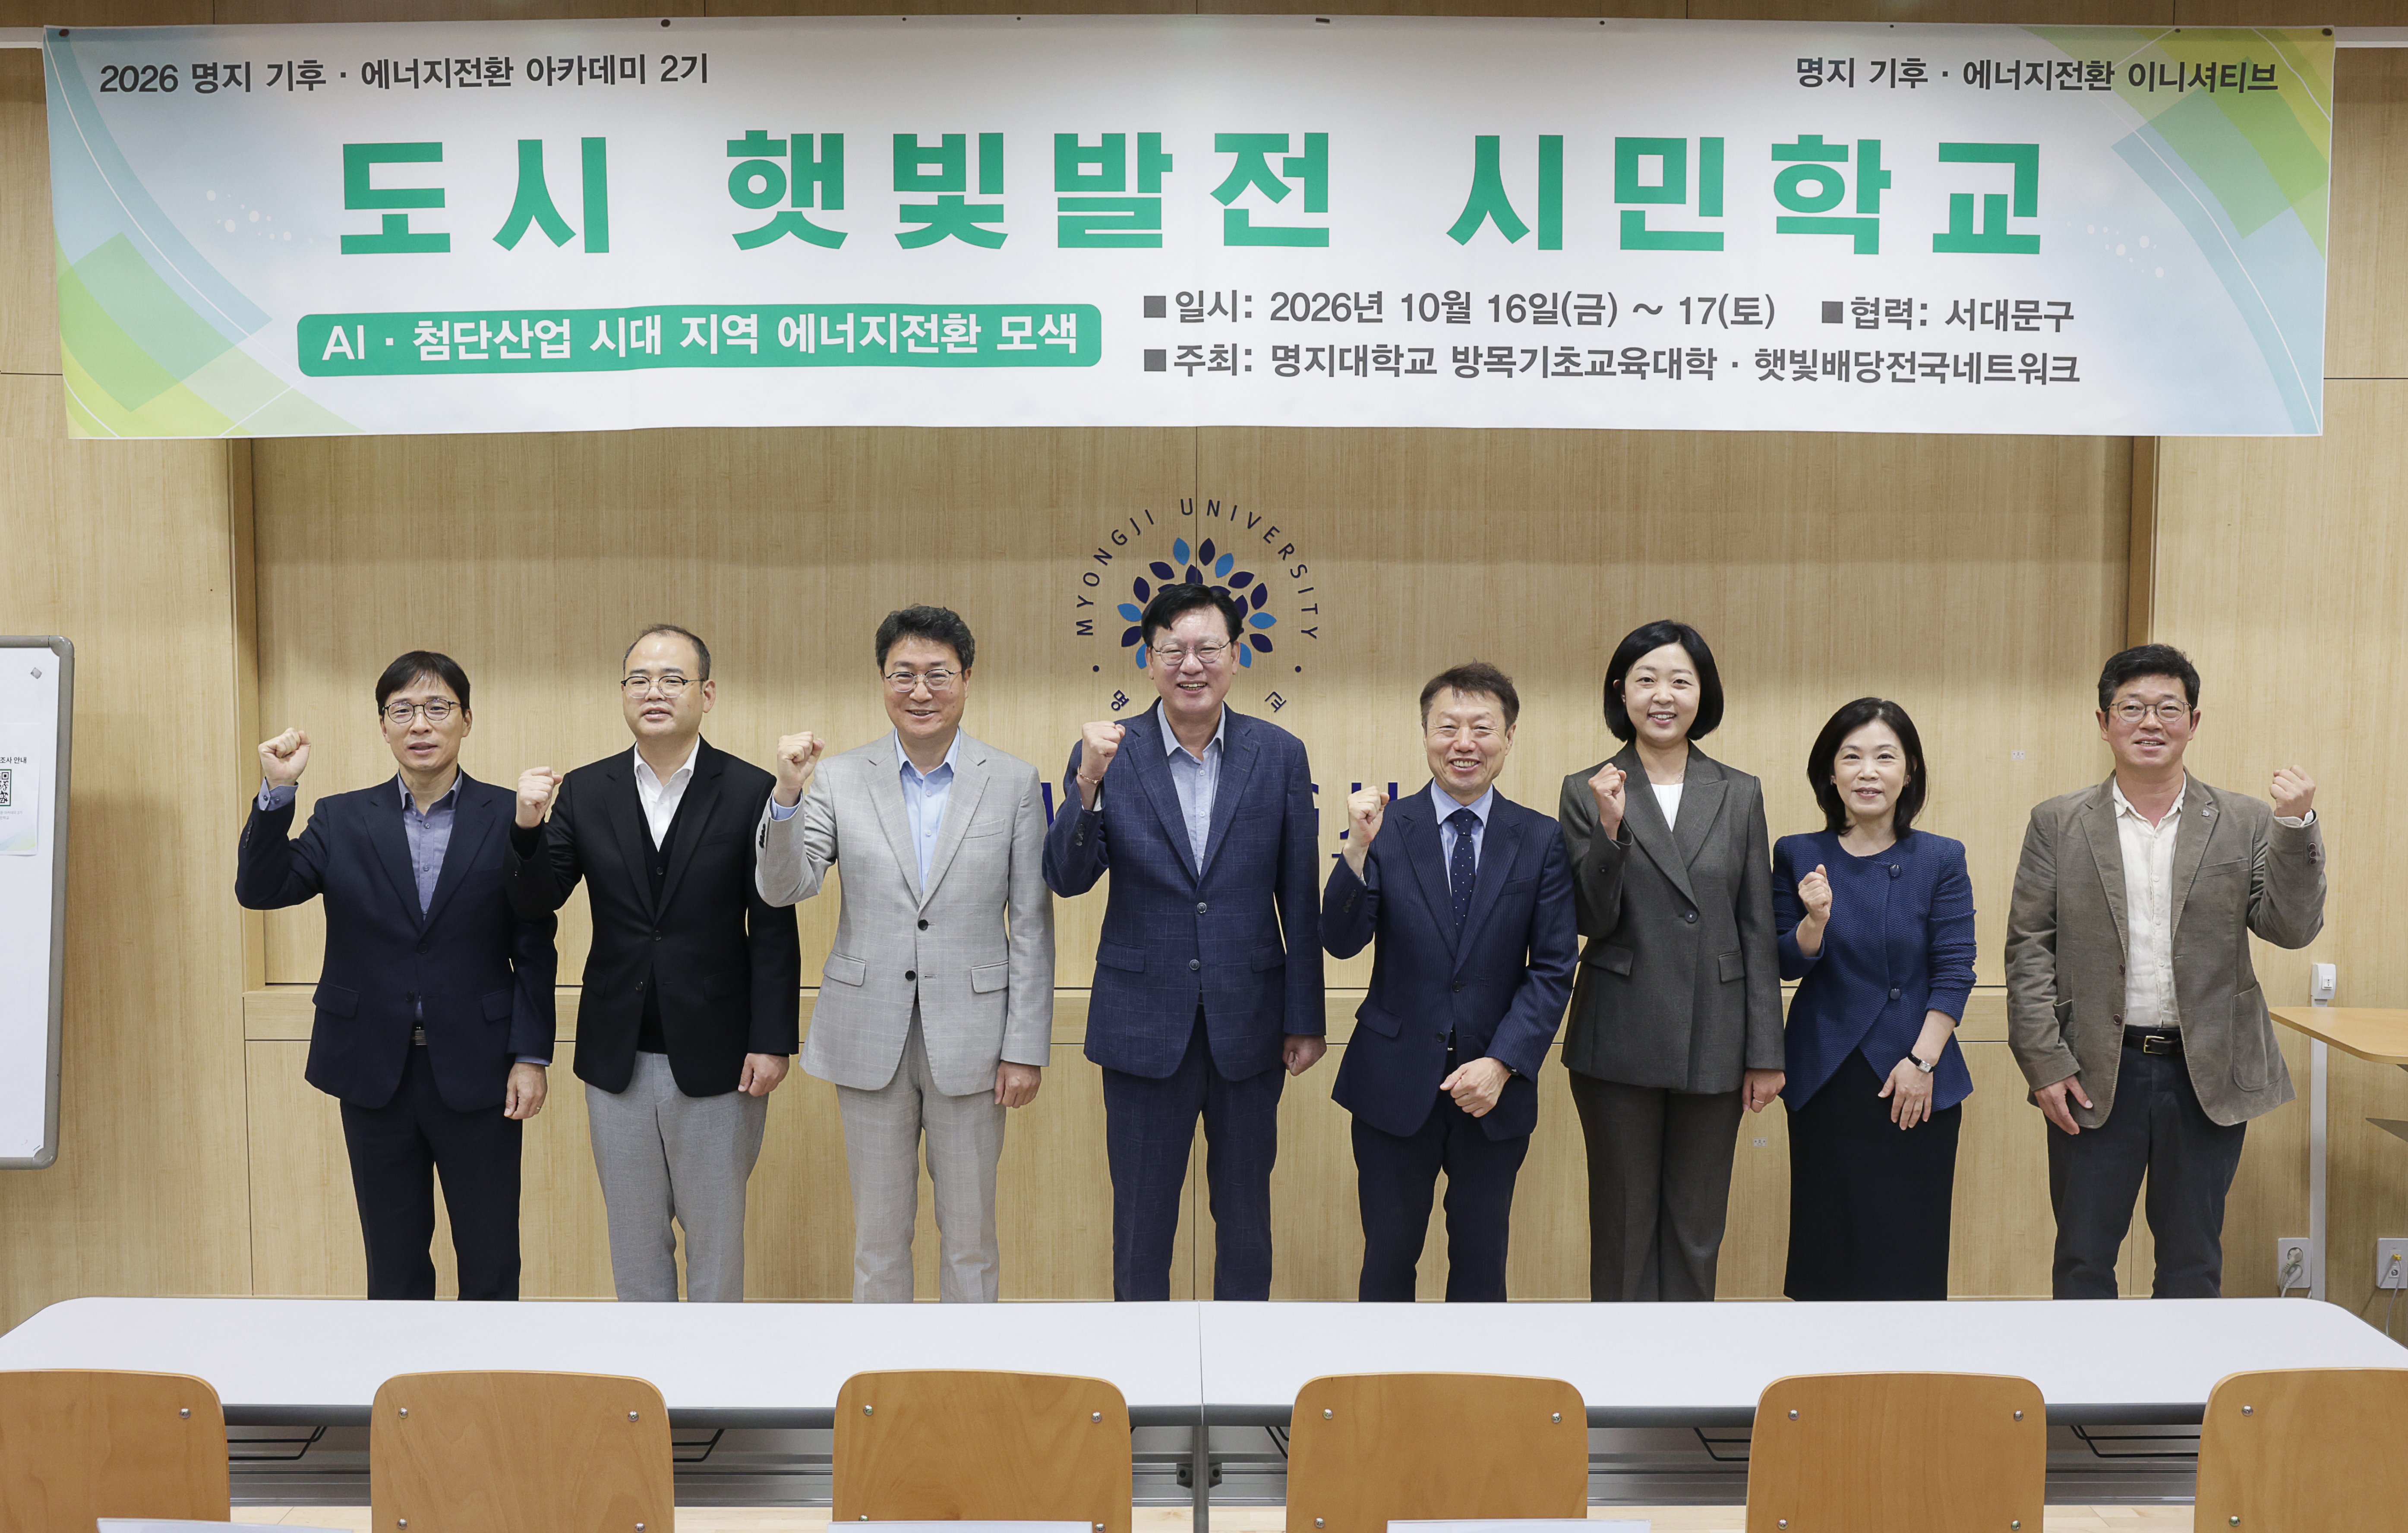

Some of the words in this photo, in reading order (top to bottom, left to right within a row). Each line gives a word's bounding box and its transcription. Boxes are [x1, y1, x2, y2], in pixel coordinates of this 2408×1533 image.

[100, 63, 179, 93] 2026
[192, 61, 251, 94] 명지
[266, 60, 326, 91] 기후
[361, 57, 514, 89] 에너지전환
[527, 54, 645, 86] 아카데미
[660, 53, 707, 83] 2기
[1797, 57, 1854, 88] 명지
[1869, 58, 1928, 89] 기후
[1963, 59, 2115, 91] 에너지전환
[2128, 59, 2279, 94] 이니셔티브
[341, 137, 609, 254] 도시
[727, 130, 1329, 250] 햇빛발전
[1447, 135, 2040, 255] 시민학교
[1176, 290, 1252, 323] 일시:
[1270, 291, 1382, 323] 2026년
[1401, 290, 1471, 324] 10월
[1488, 291, 1617, 328] 16일(금)
[1680, 293, 1774, 329] 17(토)
[1851, 297, 1927, 330] 협력:
[1945, 299, 2074, 332] 서대문구
[322, 325, 365, 361] AI
[413, 319, 571, 361] 첨단산업
[589, 314, 662, 358] 시대
[679, 313, 758, 354] 지역
[777, 312, 982, 354] 에너지전환
[997, 313, 1077, 354] 모색
[1174, 343, 1252, 377] 주최:
[1272, 344, 1437, 377] 명지대학교
[1452, 346, 1717, 381] 방목기초교육대학
[1755, 348, 2080, 385] 햇빛배당전국네트워크
[1076, 509, 1154, 635] MYONGJI
[1180, 498, 1318, 639] UNIVERSITY
